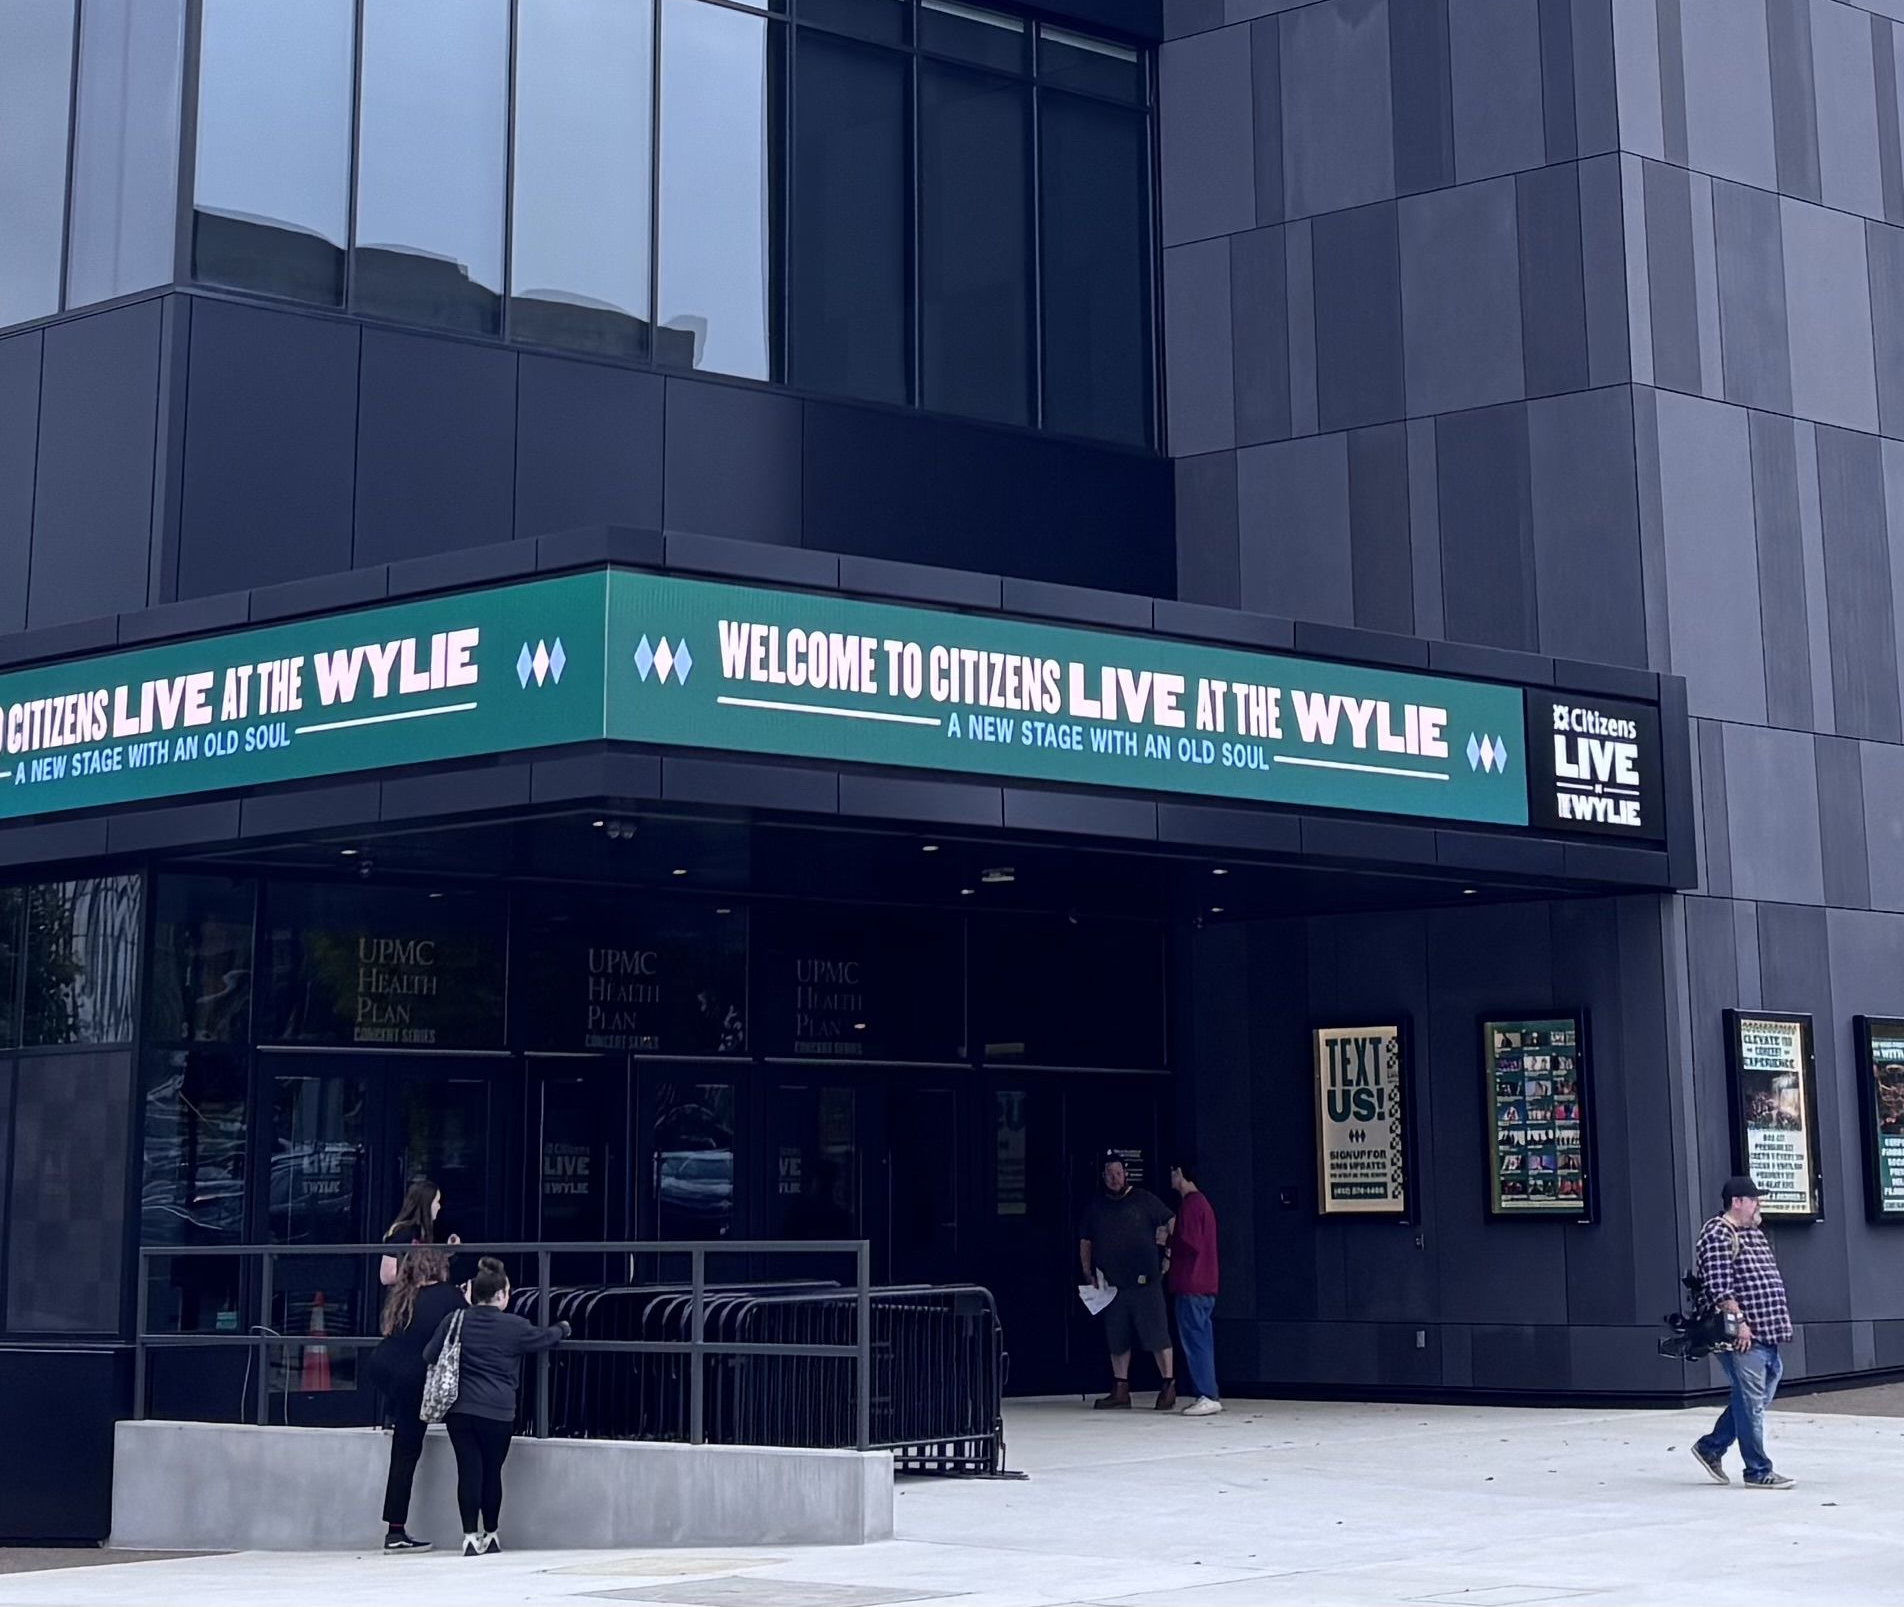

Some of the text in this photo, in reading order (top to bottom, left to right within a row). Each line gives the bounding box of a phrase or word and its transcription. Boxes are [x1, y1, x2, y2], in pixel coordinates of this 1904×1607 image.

[8, 689, 109, 755] CITIZENS
[113, 671, 214, 738] LIVE
[221, 665, 253, 722] AT
[257, 656, 304, 715] THE
[313, 627, 480, 706] WYLIE
[718, 620, 1449, 758] WELCOME TO CITIZENS LIVE AT THE WYLIE
[1571, 708, 1637, 739] Citizens
[14, 722, 291, 785] A NEW STAGE WITH AN OLD SOUL
[947, 712, 1270, 770] A NEW STAGE WITH AN OLD SOUL
[1554, 734, 1639, 785] LIVE
[1571, 794, 1641, 826] WYLIE
[358, 937, 435, 965] UPMC
[589, 948, 657, 975] UPMC
[358, 968, 436, 995] HEALTH
[357, 995, 411, 1023] PLAN
[1325, 1036, 1382, 1087] TEXT
[1327, 1087, 1386, 1123] US!
[544, 1155, 590, 1176] LIVE
